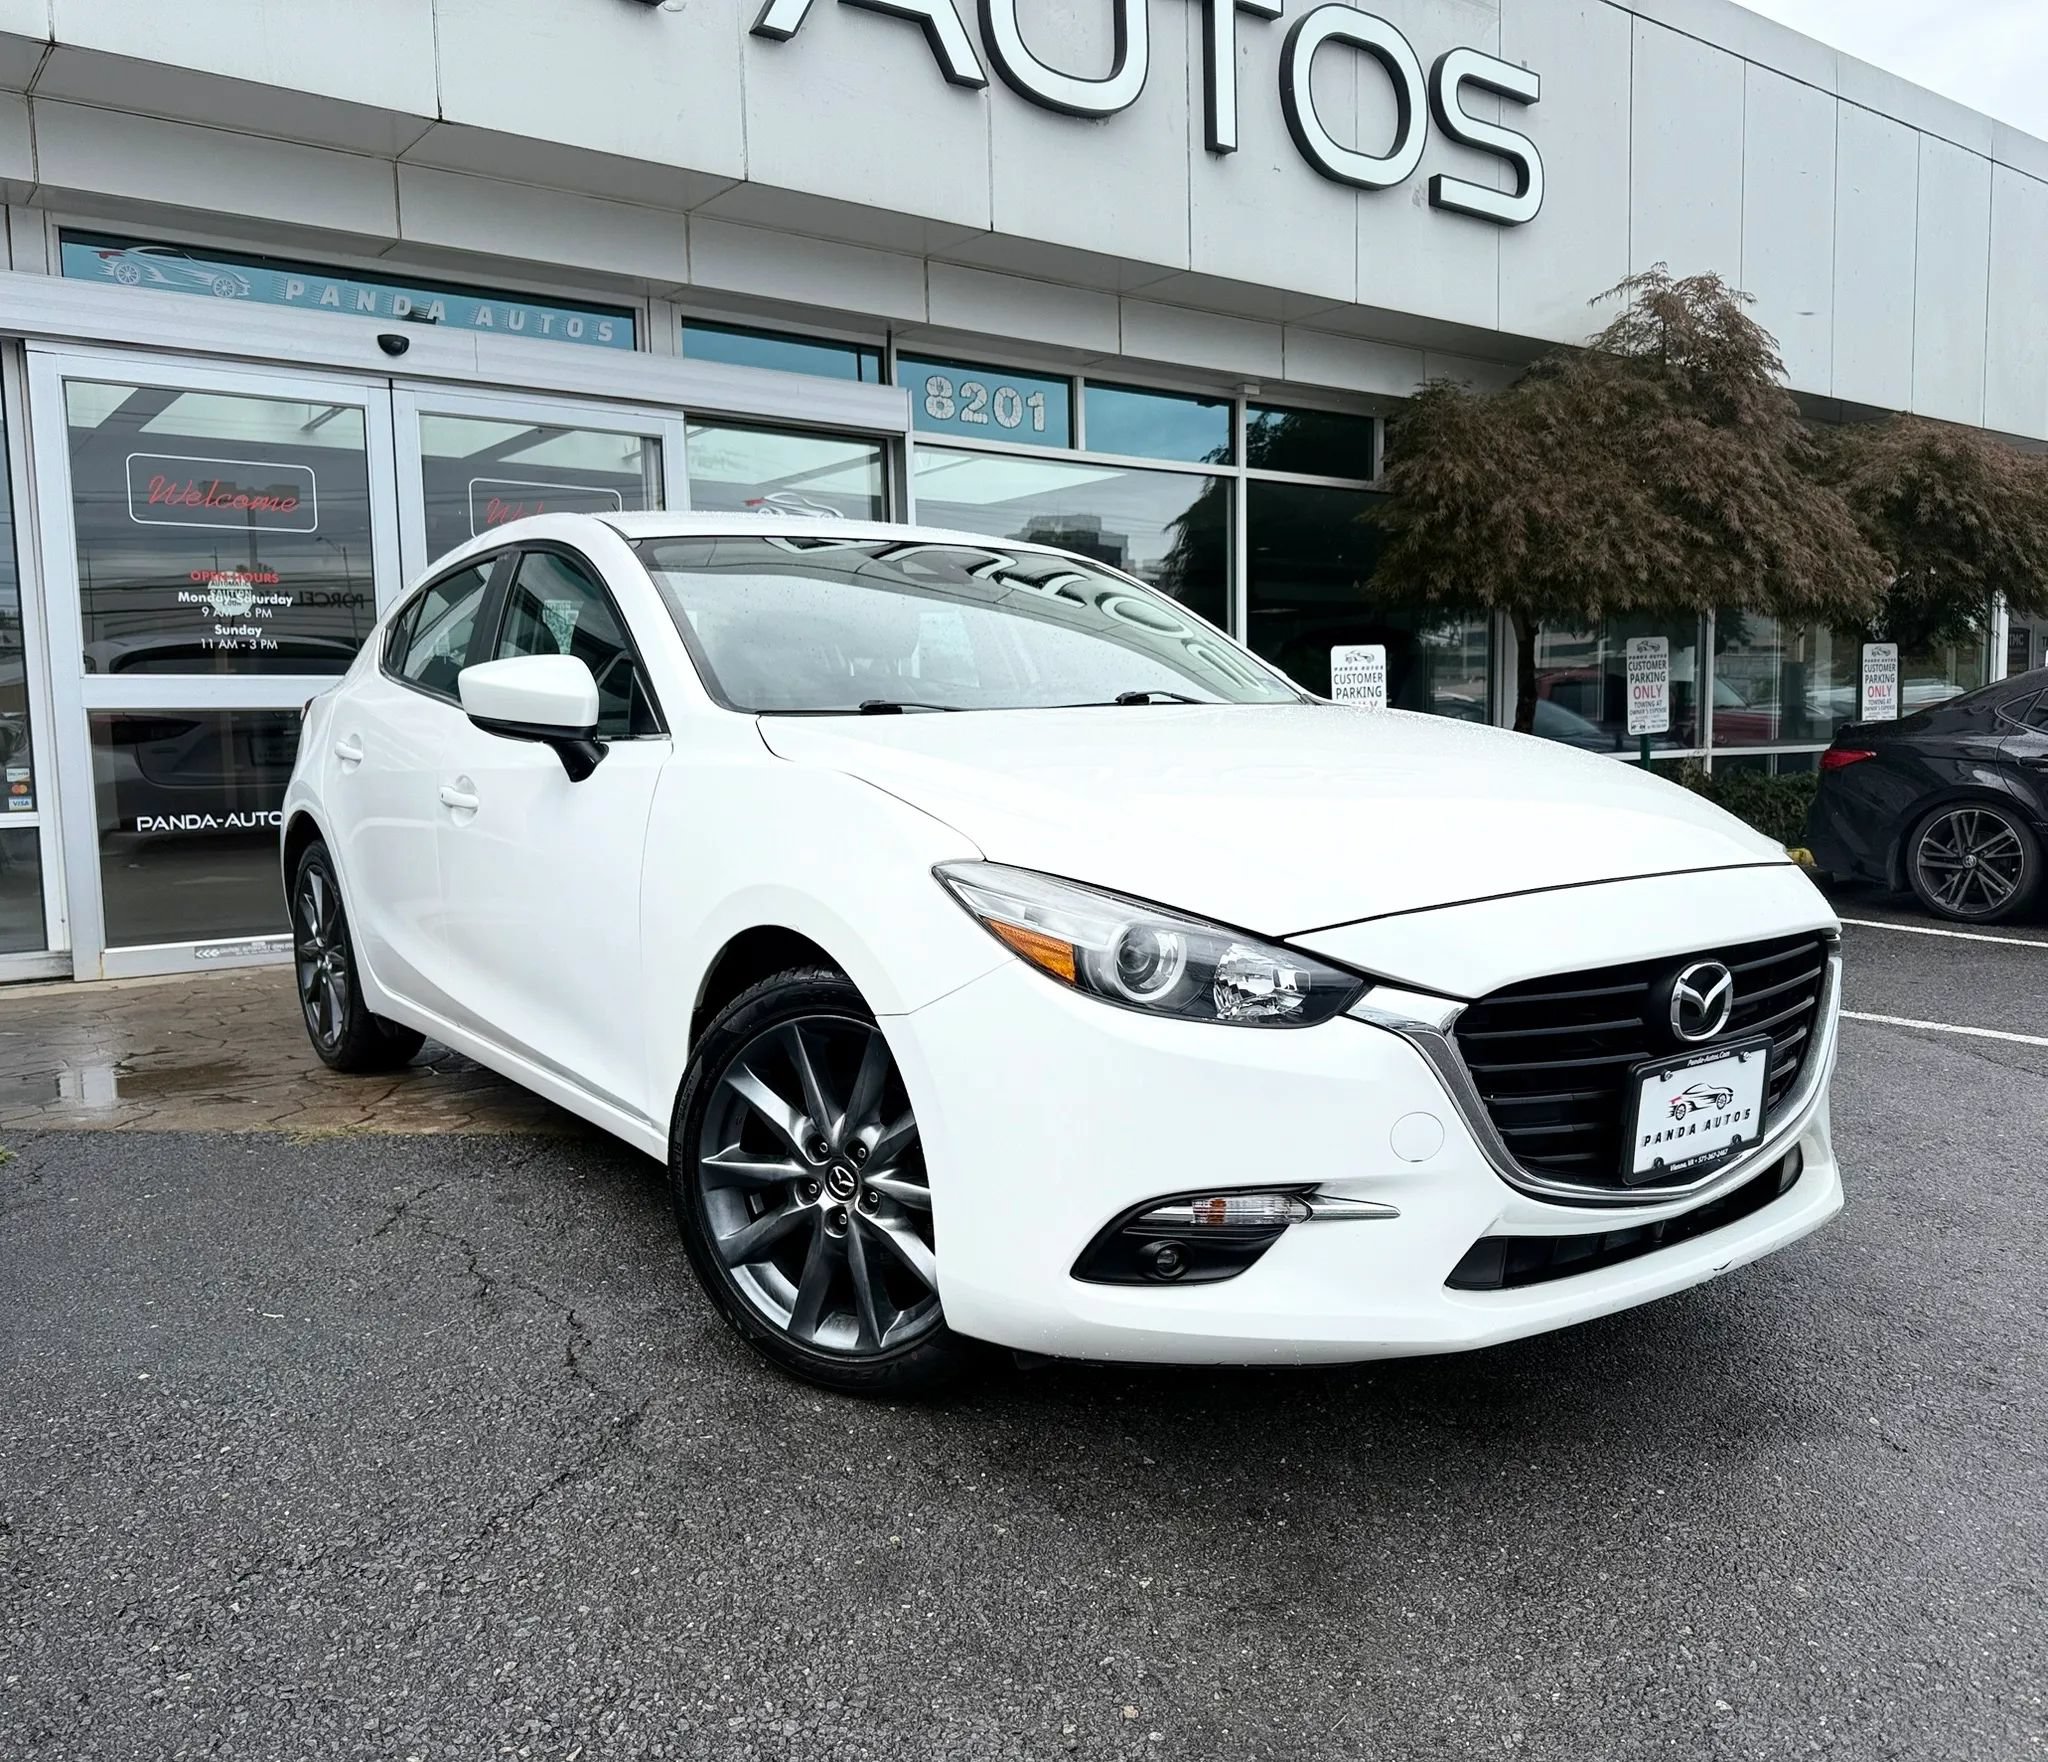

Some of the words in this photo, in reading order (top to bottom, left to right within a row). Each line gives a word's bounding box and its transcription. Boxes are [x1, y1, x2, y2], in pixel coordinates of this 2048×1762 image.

[283, 277, 448, 328] PANDA
[474, 303, 614, 343] AUTOS
[924, 374, 1046, 433] 8201
[149, 475, 300, 512] Welcome
[178, 592, 293, 608] Monday-Saturday
[201, 606, 210, 617] 9
[255, 608, 272, 619] PM
[214, 624, 262, 638] Sunday
[201, 639, 213, 649] 11
[218, 639, 238, 649] AM
[249, 639, 257, 650] 3
[260, 639, 278, 650] PM
[1628, 660, 1667, 671] CUSTOMER
[1864, 664, 1896, 672] CUSTOMER
[1333, 672, 1384, 685] CUSTOMER
[1630, 672, 1666, 684] PARKING
[1865, 674, 1895, 684] PARKING
[1336, 685, 1383, 699] PARKING
[1633, 685, 1662, 699] ONLY
[1868, 685, 1892, 698] ONLY
[1643, 1123, 1696, 1147] PANDA
[1703, 1108, 1751, 1131] AUTOS
